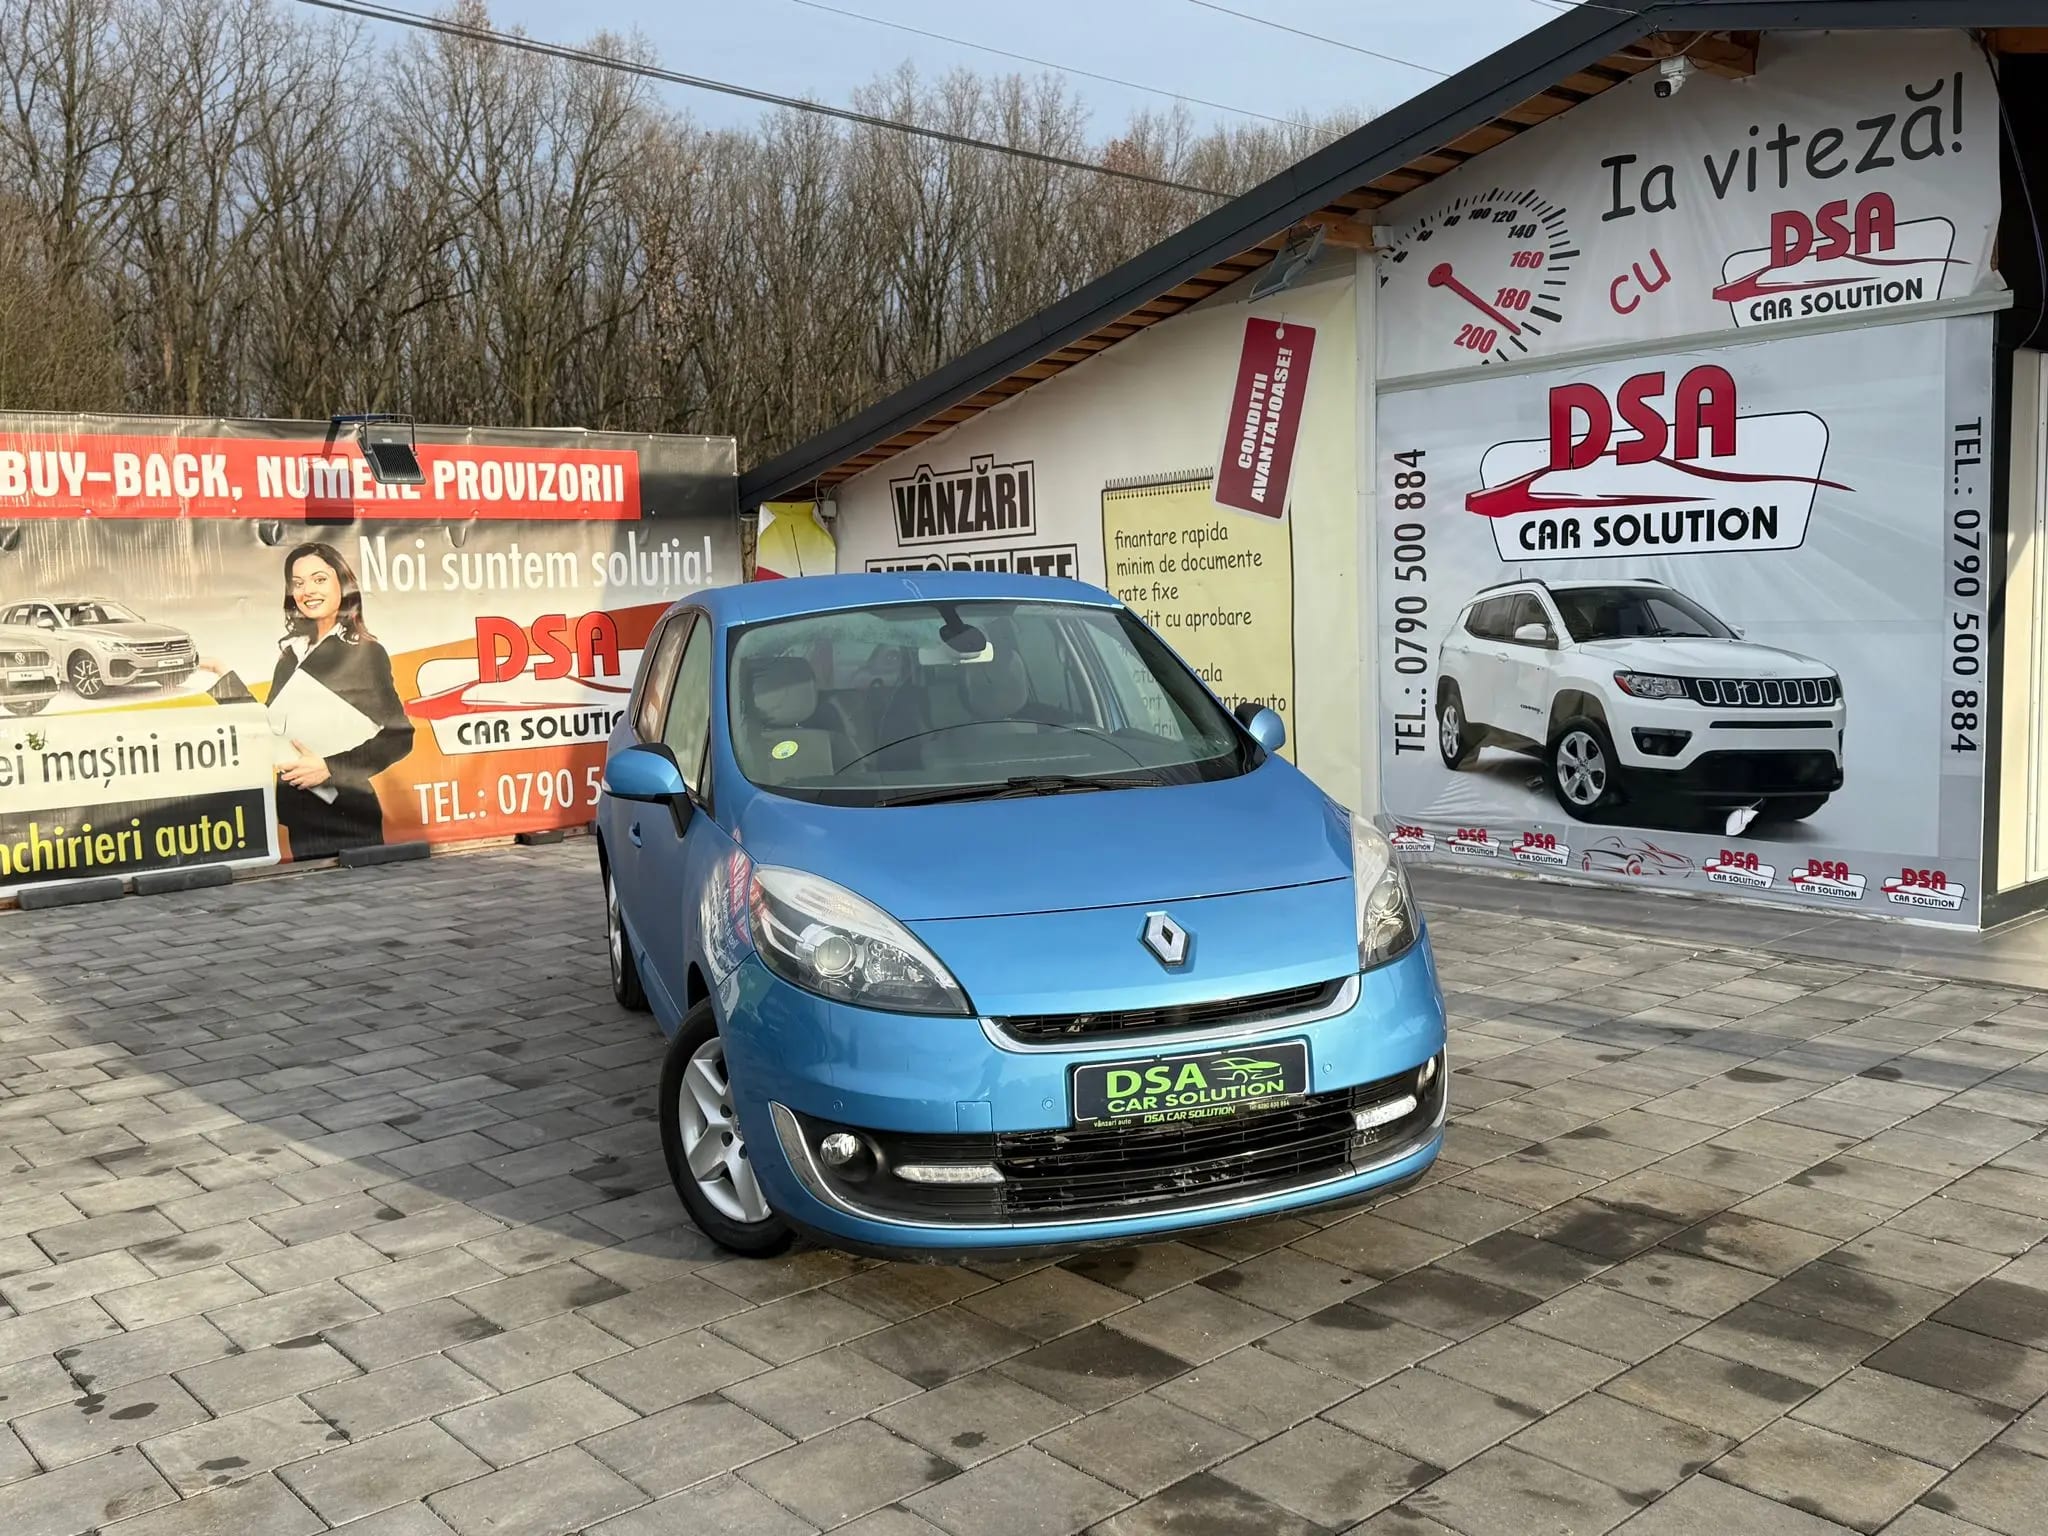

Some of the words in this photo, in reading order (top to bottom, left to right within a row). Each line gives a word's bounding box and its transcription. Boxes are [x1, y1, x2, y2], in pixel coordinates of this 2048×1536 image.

[1601, 154, 1677, 222] Ia
[1703, 71, 1963, 200] viteză!
[1492, 209, 1517, 223] 120
[1507, 224, 1537, 238] 140
[1771, 191, 1895, 267] DSA
[1510, 251, 1544, 269] 160
[1610, 248, 1671, 314] cu
[1493, 287, 1531, 310] 180
[1750, 297, 1792, 322] CAR
[1801, 278, 1923, 315] SOLUTION
[1454, 323, 1497, 353] 200
[1238, 373, 1268, 469] CONDITII
[1251, 347, 1293, 503] AVANTAJOASE!
[1549, 364, 1736, 471] DSA
[0, 451, 243, 500] BUY-BACK,
[433, 460, 624, 502] PROVIZORII
[1954, 416, 1982, 495] TEL.:
[895, 464, 1030, 538] VÂNZĂRI
[1394, 449, 1426, 510] 884
[1115, 529, 1177, 550] finantare
[1182, 521, 1228, 548] rapida
[1519, 517, 1581, 551] CAR
[1594, 505, 1778, 547] SOLUTION
[360, 536, 427, 592] Noi
[442, 543, 579, 590] suntem
[1116, 557, 1154, 576] minim
[1159, 554, 1176, 573] de
[1181, 550, 1263, 571] documente
[1394, 523, 1427, 582] 500
[1953, 509, 1981, 597] 0790
[1118, 585, 1147, 602] rate
[1152, 581, 1179, 602] fixe
[1142, 609, 1160, 628] dit
[1165, 615, 1181, 628] cu
[1185, 606, 1252, 632] aprobare
[1394, 597, 1427, 675] 0790
[475, 611, 620, 683] DSA
[1952, 612, 1980, 676] 500
[457, 719, 510, 745] CAR
[521, 710, 625, 741] SOLUTI
[1395, 687, 1427, 755] TEL.:
[1950, 690, 1978, 753] 884
[42, 735, 159, 788] mașini
[175, 725, 239, 768] noi!
[414, 780, 487, 825] TEL.:
[497, 768, 574, 815] 0790
[155, 806, 246, 857] auto!
[1457, 828, 1488, 843] DSA
[1523, 832, 1556, 849] DSA
[1519, 853, 1531, 861] CAR
[1532, 854, 1563, 864] SOLUTION
[1713, 873, 1727, 881] CAR
[1729, 874, 1766, 887] SOLUTION
[1720, 850, 1759, 870] DSA
[1808, 859, 1848, 881] DSA
[1902, 868, 1947, 890] DSA
[1801, 884, 1815, 892] CAR
[1817, 886, 1857, 897] SOLUTION
[1894, 894, 1911, 903] CAR
[1912, 896, 1955, 908] SOLUTION
[1107, 1063, 1208, 1098] DSA
[1107, 1096, 1158, 1113] CAR
[1165, 1080, 1285, 1106] SOLUTION
[1144, 1114, 1165, 1124] DSA
[1167, 1111, 1186, 1121] CAR
[1188, 1106, 1236, 1119] SOLUTION
